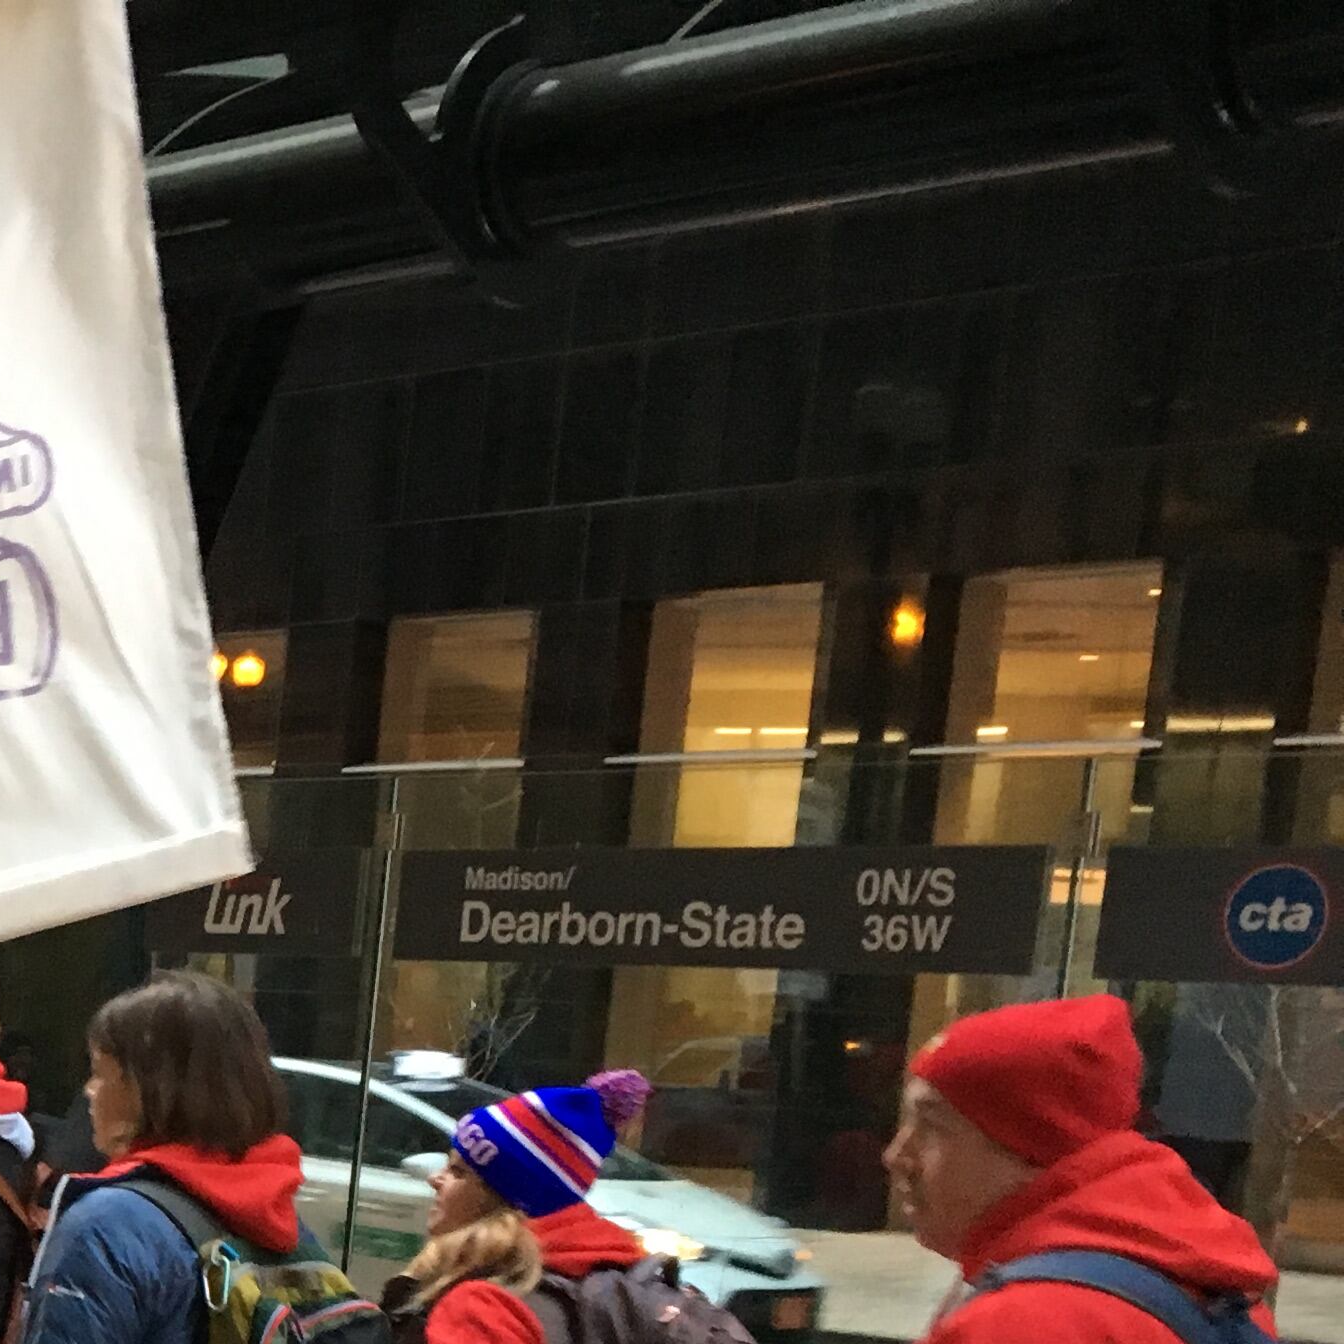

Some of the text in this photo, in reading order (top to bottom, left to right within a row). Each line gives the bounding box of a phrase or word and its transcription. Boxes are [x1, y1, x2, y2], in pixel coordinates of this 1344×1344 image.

[465, 865, 577, 892] Madison/
[461, 901, 805, 950] Dearborn-State
[1239, 895, 1313, 933] cta
[862, 914, 952, 953] 36W
